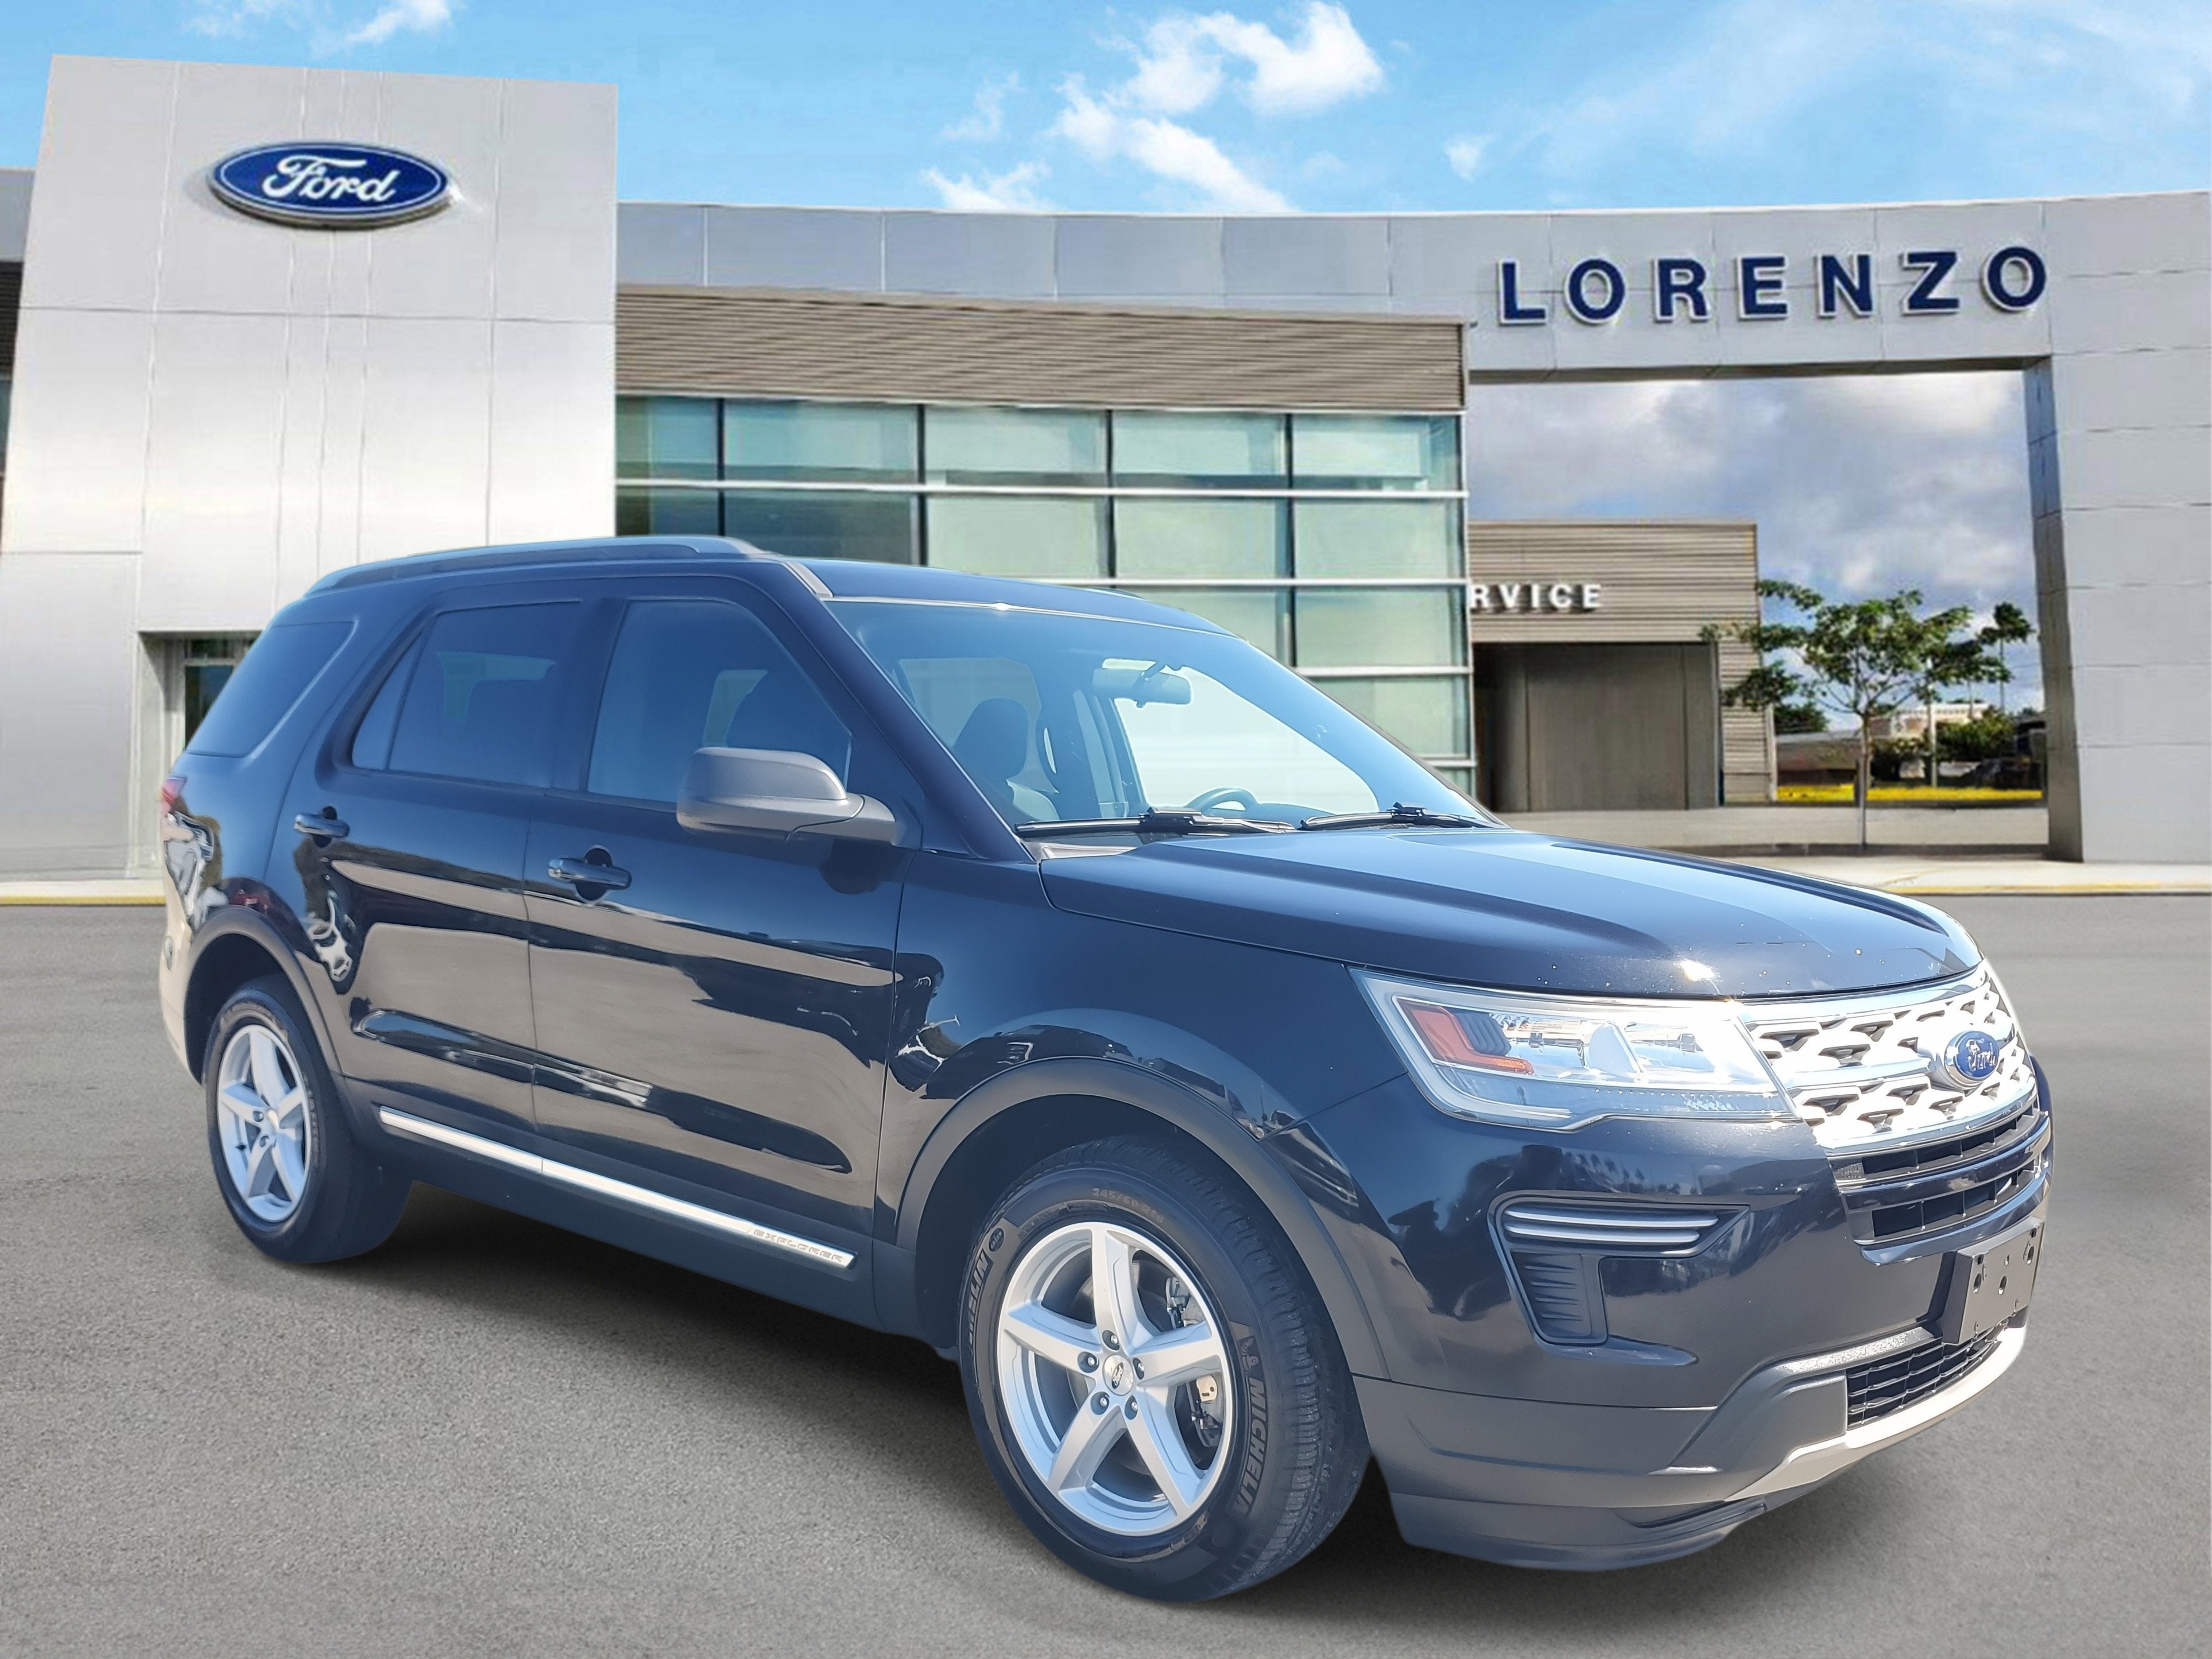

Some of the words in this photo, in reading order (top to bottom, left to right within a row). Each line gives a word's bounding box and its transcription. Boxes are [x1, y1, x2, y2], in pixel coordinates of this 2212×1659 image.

[262, 154, 401, 201] Ford
[1499, 246, 2047, 323] LORENZO
[753, 1229, 843, 1262] EXPLORER
[1234, 1377, 1266, 1516] MICHELIN
